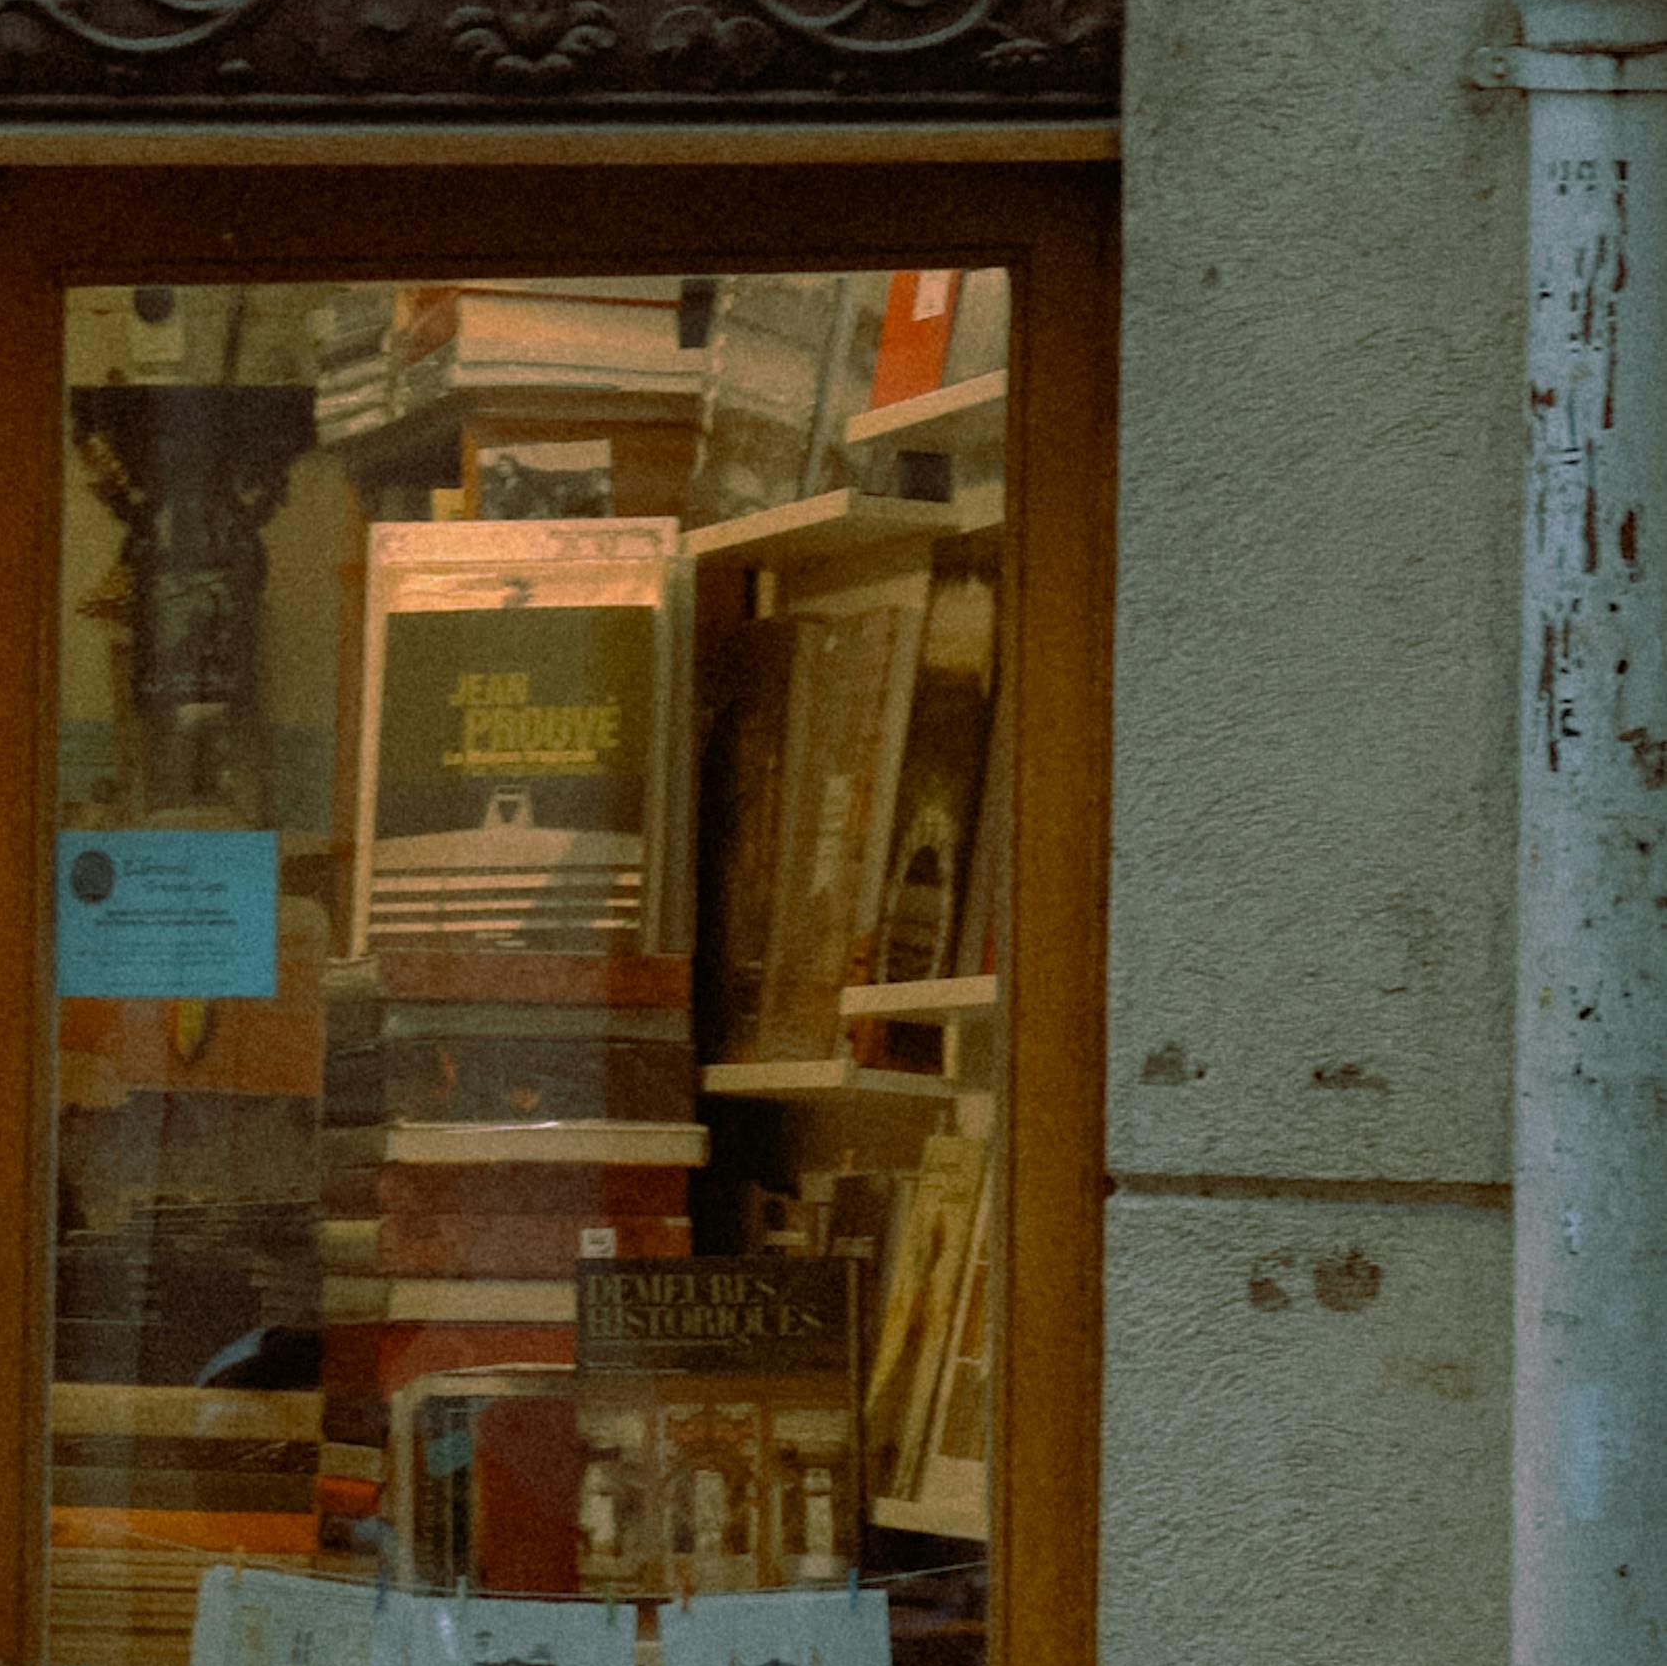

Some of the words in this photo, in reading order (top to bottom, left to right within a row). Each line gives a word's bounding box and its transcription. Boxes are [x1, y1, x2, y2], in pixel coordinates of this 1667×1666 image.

[449, 672, 530, 706] JEAN
[588, 1274, 777, 1305] DEMEURES
[586, 1305, 824, 1344] HISTORIQUES
